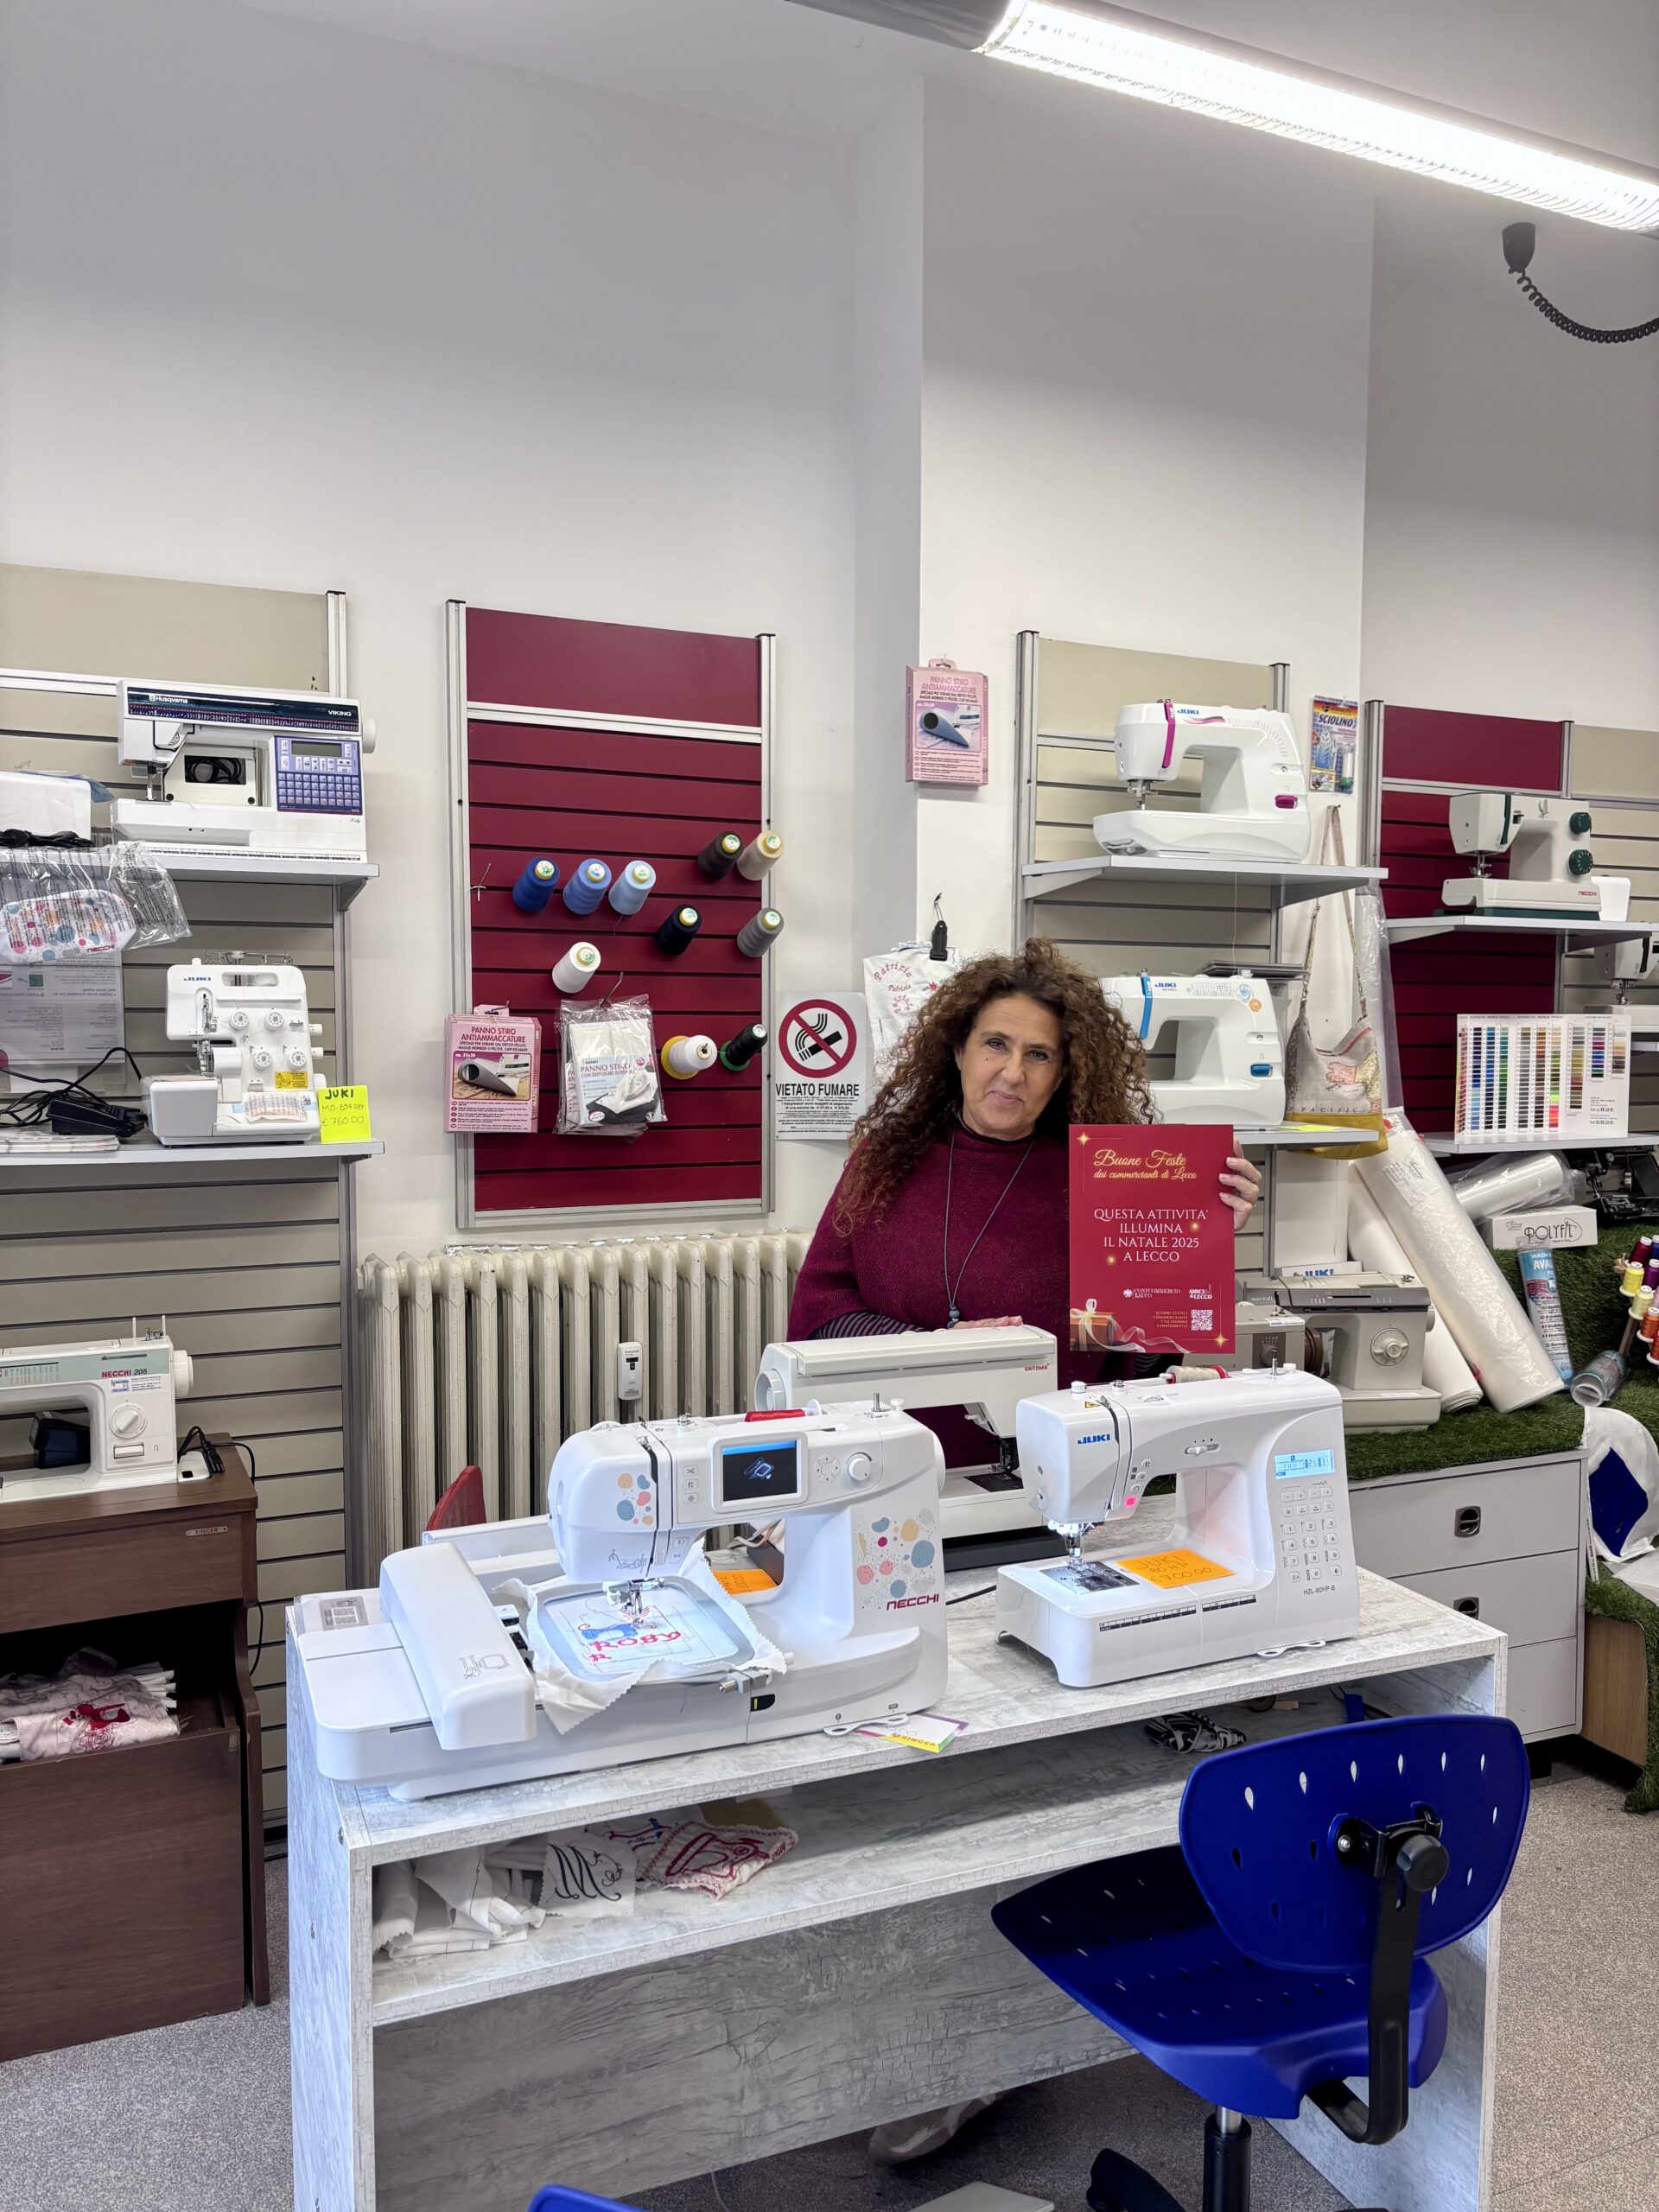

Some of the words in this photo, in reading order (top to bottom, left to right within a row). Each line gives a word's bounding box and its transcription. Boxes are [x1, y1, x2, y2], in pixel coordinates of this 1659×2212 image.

[931, 676, 951, 684] PANNO
[922, 683, 976, 694] ANTIAMMACCATURE
[1319, 714, 1353, 728] SCIOLINO
[874, 962, 912, 982] Patrizia
[461, 1034, 525, 1043] ANTIAMMACCATURE
[325, 1089, 353, 1099] JUKI
[776, 1084, 815, 1096] VIETATO
[818, 1084, 859, 1096] FUMARE
[1094, 1149, 1141, 1166] Buone
[1146, 1149, 1185, 1168] Feste
[1094, 1169, 1107, 1179] dai
[1109, 1170, 1158, 1179] commercianti
[1161, 1169, 1169, 1179] di
[1172, 1166, 1198, 1182] Lecco
[1094, 1209, 1146, 1221] QUESTA
[1147, 1210, 1209, 1219] ATTIVITA'
[1120, 1224, 1183, 1233] ILLUMINA
[1104, 1237, 1115, 1247] IL
[1118, 1237, 1168, 1247] NATALE
[1172, 1237, 1199, 1248] 2025
[1123, 1251, 1132, 1262] A
[1136, 1251, 1179, 1262] LECCO
[102, 1370, 131, 1378] NECCHI
[1077, 1434, 1110, 1445] JUKI
[1135, 1555, 1185, 1569] JUKI
[1304, 1586, 1335, 1595] HZL-80HP-B
[887, 1593, 939, 1611] NECCHI
[588, 1631, 681, 1651] ROBY
[901, 1733, 936, 1747] SINGER
